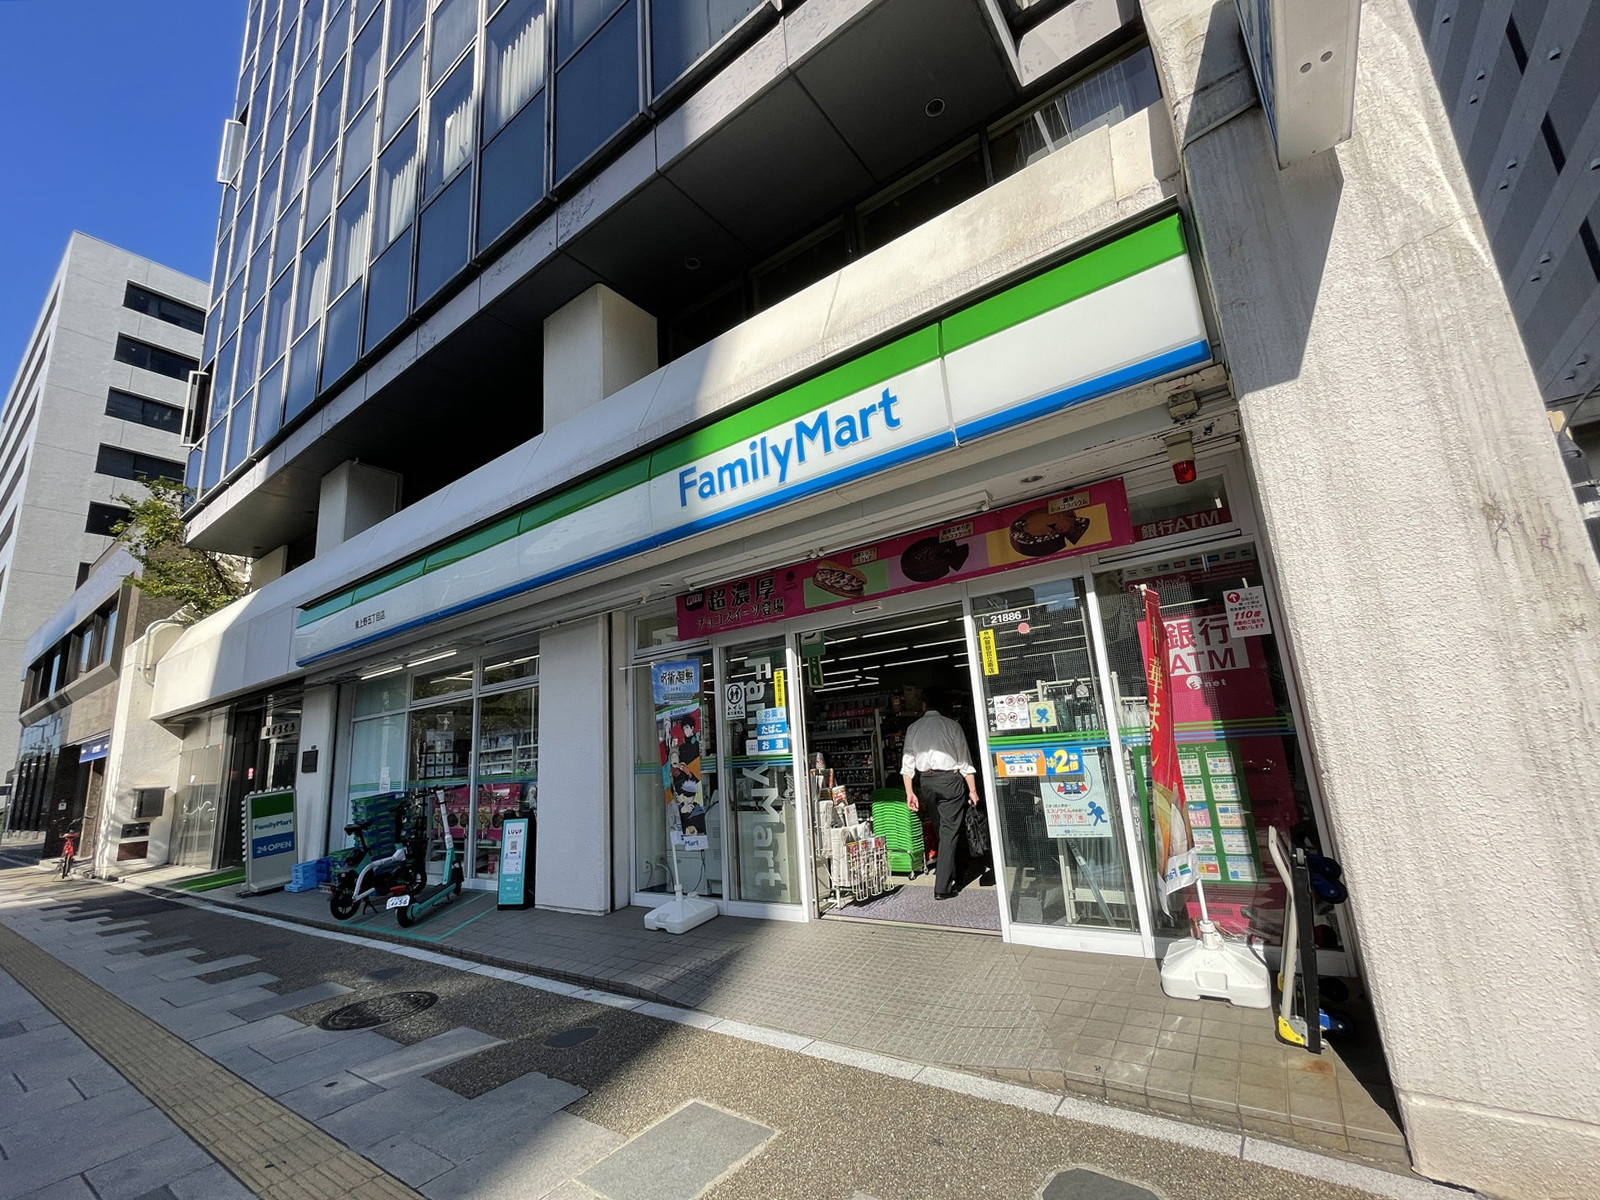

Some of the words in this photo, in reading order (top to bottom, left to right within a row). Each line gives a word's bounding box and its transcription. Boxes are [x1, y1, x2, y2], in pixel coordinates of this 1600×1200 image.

[678, 387, 901, 508] FamilyMart
[1141, 511, 1220, 539] 銀行ATM
[709, 575, 775, 612] 超濃厚
[697, 597, 784, 631] チョコスイーツ登場
[990, 611, 1022, 624] 21886
[1171, 647, 1237, 675] ATM
[761, 724, 783, 735] たばこ
[255, 819, 292, 830] FamilyMart
